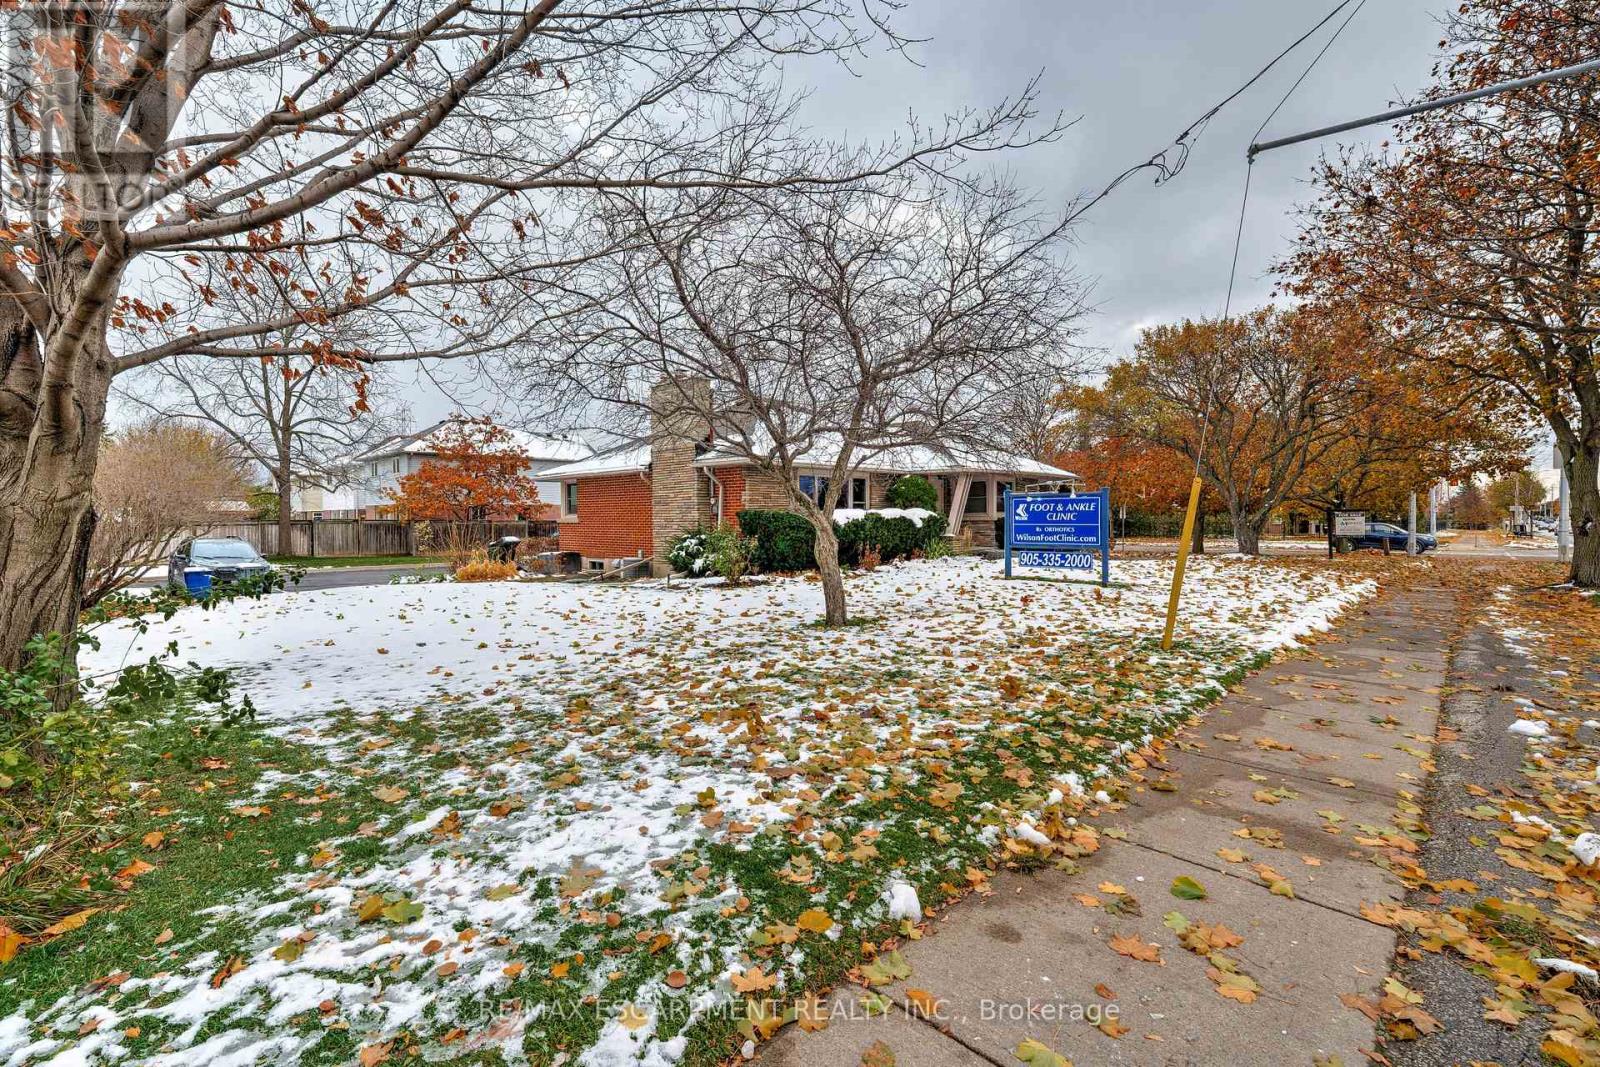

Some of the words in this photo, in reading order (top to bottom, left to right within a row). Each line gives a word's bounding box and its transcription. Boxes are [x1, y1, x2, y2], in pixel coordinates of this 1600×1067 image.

[1029, 503, 1055, 511] FOOT
[1056, 503, 1063, 511] &
[1066, 503, 1096, 511] ANKLE
[1046, 512, 1077, 520] CLINIC
[1016, 534, 1096, 542] WilsonFootClinic.com
[1020, 553, 1091, 567] 905-335-2000
